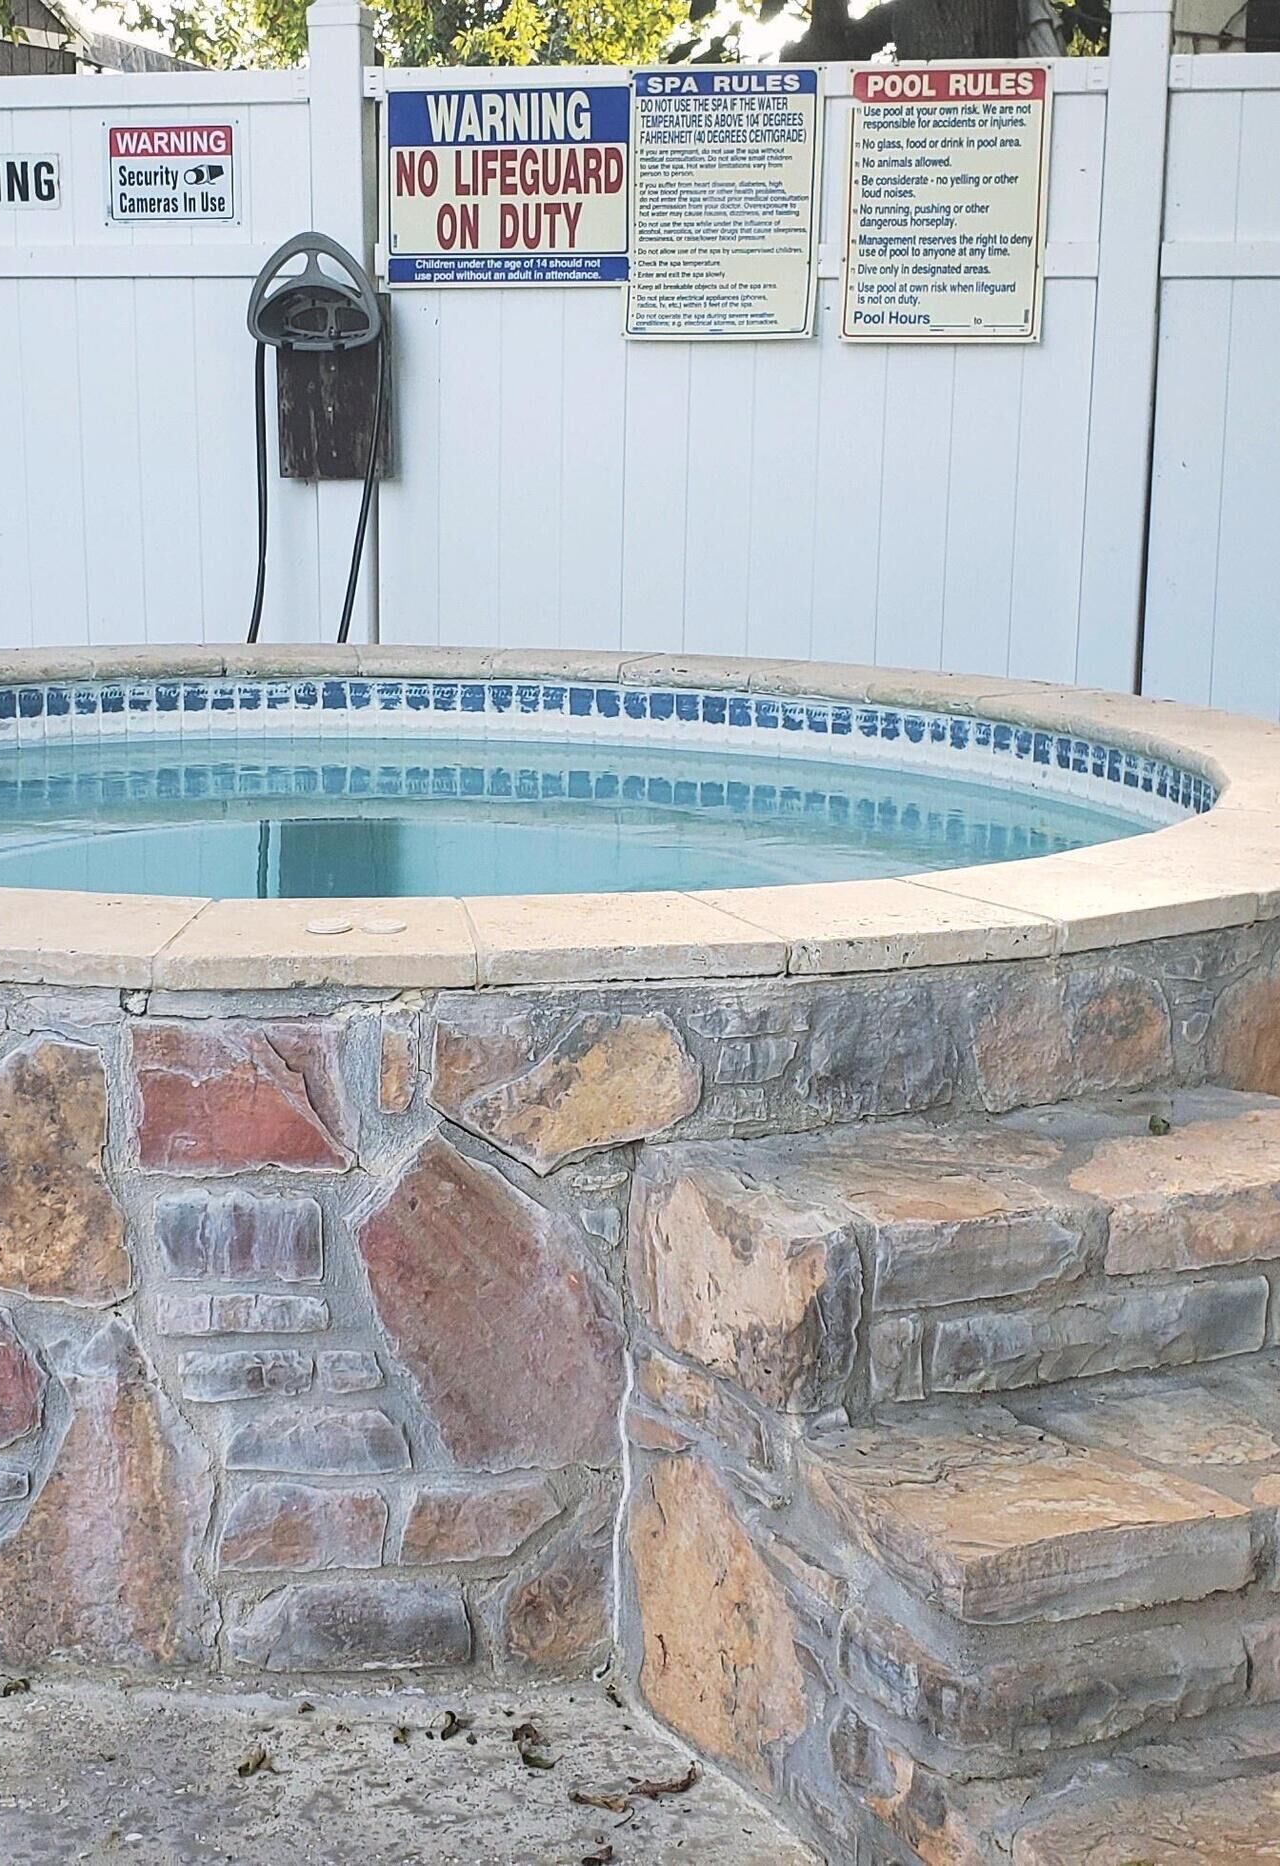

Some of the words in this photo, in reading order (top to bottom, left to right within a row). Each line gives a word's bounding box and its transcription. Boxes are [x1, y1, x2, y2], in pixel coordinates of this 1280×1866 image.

[647, 77, 698, 93] SPA
[713, 75, 800, 92] RULES
[867, 74, 936, 97] POOL
[949, 72, 1033, 96] RULES
[641, 99, 653, 112] DO
[655, 99, 672, 112] NOT
[675, 99, 691, 112] USE
[693, 98, 709, 112] THE
[712, 98, 728, 112] SPA
[730, 98, 737, 110] IF
[740, 98, 755, 110] THE
[758, 97, 788, 110] WATER
[864, 106, 881, 116] Use
[884, 106, 902, 118] pool
[905, 107, 914, 116] at
[916, 107, 937, 118] your
[939, 107, 958, 115] own
[961, 105, 980, 114] risk.
[983, 104, 997, 114] We
[1000, 105, 1013, 114] are
[1016, 104, 1031, 113] not
[426, 91, 591, 142] WARNING
[641, 114, 703, 128] TEMPERATURE
[705, 114, 712, 127] IS
[715, 114, 743, 127] ABOVE
[763, 113, 803, 127] DEGREES
[863, 118, 915, 131] responsible
[918, 118, 931, 128] for
[933, 117, 976, 128] accidents
[978, 119, 988, 127] or
[991, 116, 1026, 129] injuries.
[116, 130, 227, 153] WARNING
[640, 131, 692, 144] FAHRENHEIT
[694, 130, 705, 144] (40
[707, 129, 747, 143] DEGREES
[749, 129, 806, 144] CENTIGRADE)
[862, 139, 875, 149] No
[878, 138, 903, 152] glass,
[907, 138, 926, 148] food
[929, 140, 938, 148] or
[941, 137, 964, 148] drink
[966, 137, 974, 147] in
[977, 137, 997, 150] pool
[1000, 139, 1021, 147] area.
[862, 157, 875, 168] No
[877, 157, 912, 167] animals
[915, 156, 952, 167] allowed.
[119, 165, 179, 190] Security
[396, 150, 438, 197] NO
[455, 147, 624, 196] LIFEGUARD
[862, 175, 873, 185] Be
[876, 175, 928, 185] considerate
[950, 174, 980, 188] yelling
[982, 176, 992, 184] or
[994, 173, 1019, 184] other
[862, 188, 881, 198] loud
[884, 188, 916, 198] noises.
[120, 192, 179, 213] Cameras
[183, 192, 196, 212] In
[201, 192, 225, 212] Use
[860, 204, 872, 214] No
[875, 204, 912, 216] running,
[914, 203, 951, 216] pushing
[965, 203, 990, 213] other
[437, 203, 479, 250] ON
[500, 202, 583, 249] DUTY
[860, 217, 908, 229] dangerous
[910, 216, 957, 228] horseplay.
[859, 234, 916, 247] Management
[919, 235, 957, 245] reserves
[960, 234, 973, 244] the
[976, 234, 997, 247] right
[1000, 234, 1008, 244] to
[1010, 234, 1033, 247] deny
[859, 248, 876, 257] use
[878, 248, 887, 257] of
[890, 247, 909, 260] pool
[912, 247, 920, 256] to
[923, 248, 955, 259] anyone
[958, 247, 966, 256] at
[969, 248, 987, 259] any
[988, 247, 1010, 256] time.
[416, 260, 455, 269] Children
[457, 260, 485, 269] under
[487, 260, 502, 268] the
[505, 261, 521, 270] age
[524, 259, 534, 268] of
[536, 259, 547, 268] 14
[549, 259, 582, 268] should
[585, 260, 600, 268] not
[858, 264, 877, 274] Dive
[880, 264, 898, 277] only
[901, 264, 909, 274] in
[912, 264, 961, 277] designated
[964, 266, 991, 274] areas.
[414, 272, 432, 281] use
[433, 271, 454, 282] pool
[456, 271, 491, 280] without
[493, 272, 506, 280] an
[508, 270, 532, 280] adult
[534, 270, 543, 279] in
[545, 270, 601, 280] attendance.
[857, 282, 874, 293] Use
[877, 282, 896, 295] pool
[899, 283, 907, 292] at
[931, 282, 947, 292] risk
[950, 282, 974, 292] when
[976, 282, 1016, 295] lifeguard
[857, 295, 865, 304] is
[868, 295, 882, 304] not
[898, 295, 920, 306] duty.
[854, 311, 884, 324] Pool
[889, 311, 930, 324] Hours
